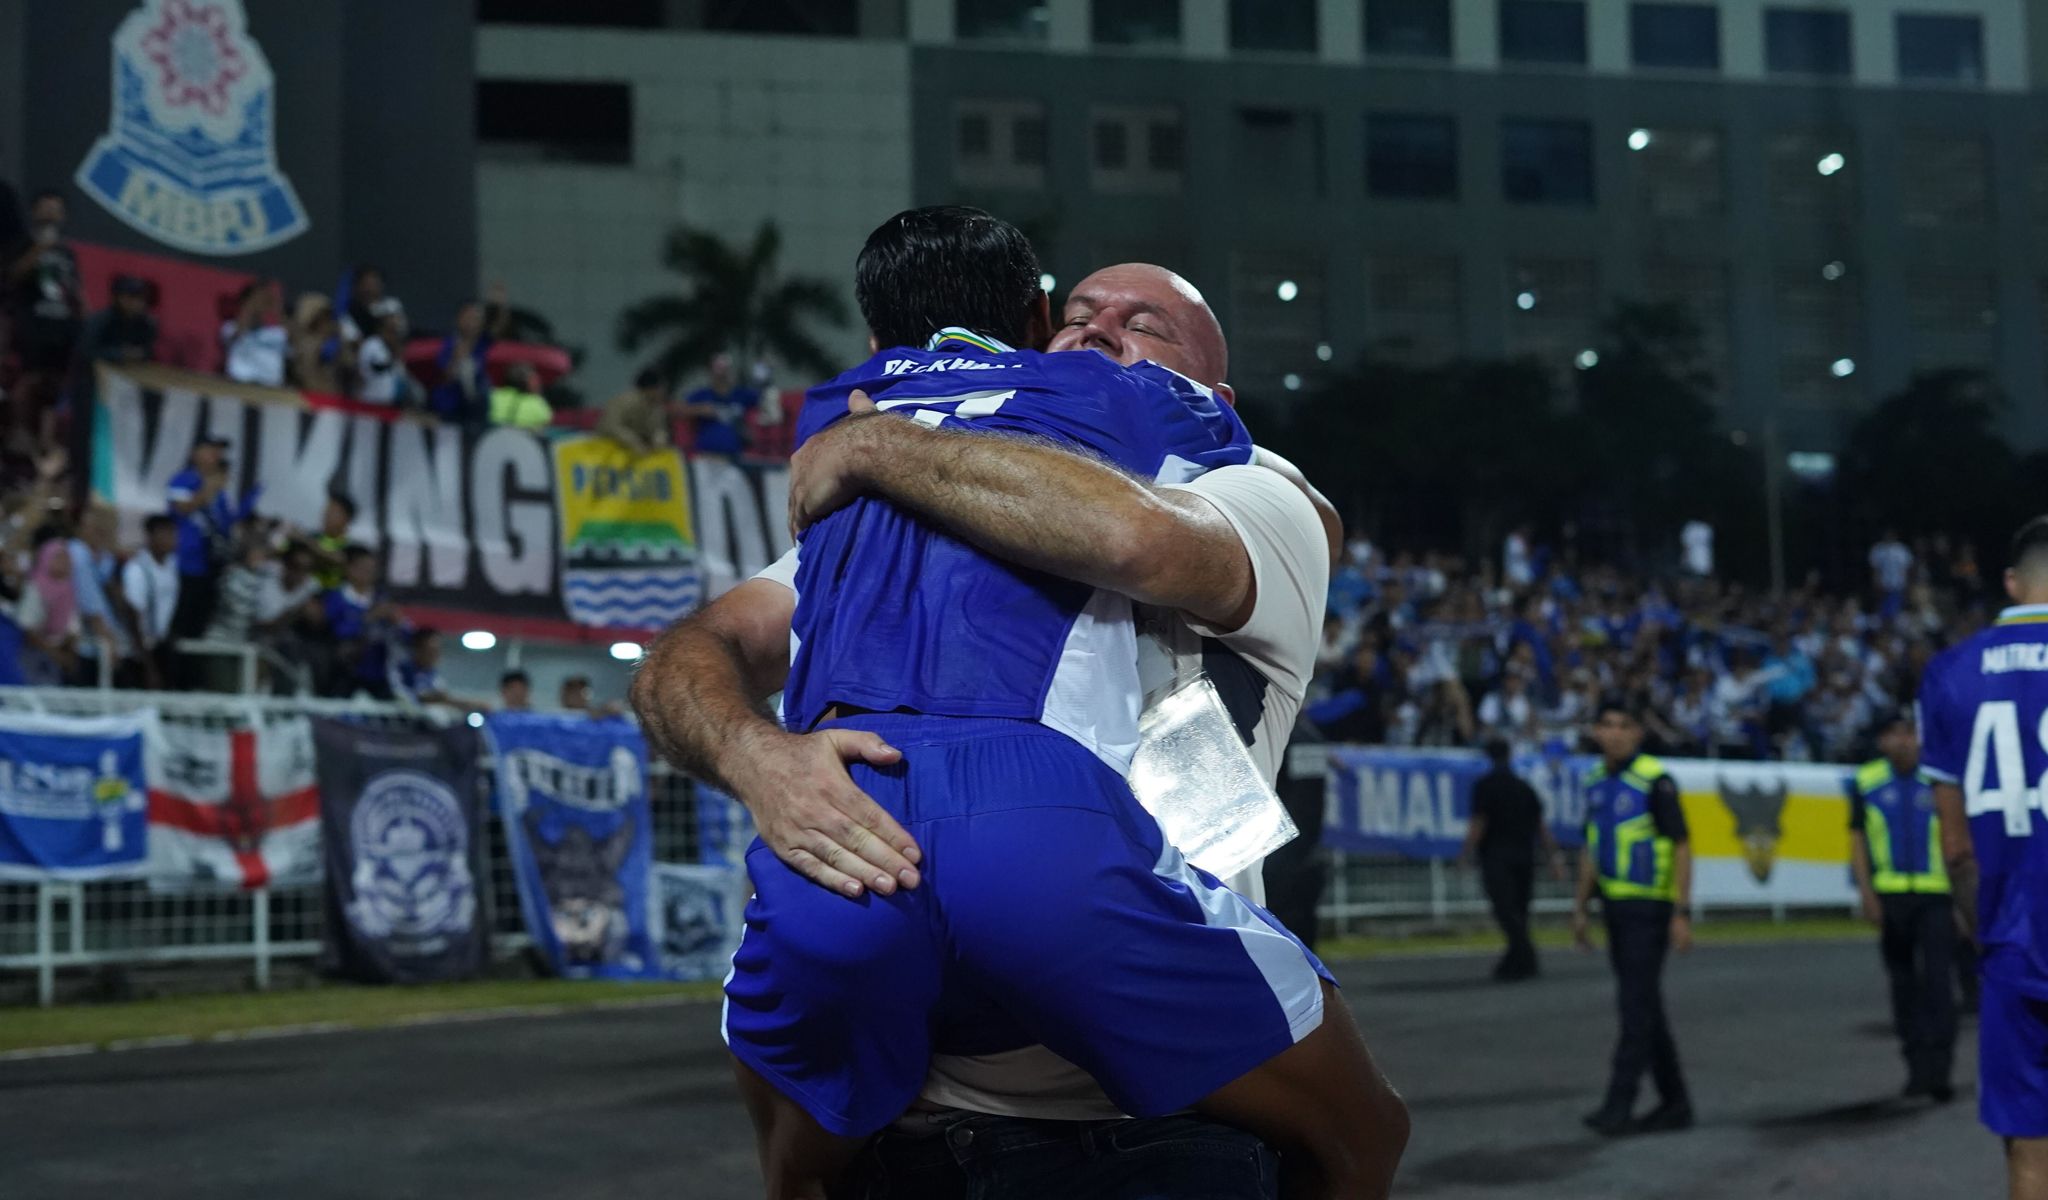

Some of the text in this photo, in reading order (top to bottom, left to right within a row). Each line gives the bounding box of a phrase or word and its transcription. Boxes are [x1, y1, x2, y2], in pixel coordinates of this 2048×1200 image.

[119, 169, 268, 244] MBPJ
[101, 369, 553, 595] VIKING
[572, 463, 673, 502] PERSIB
[1964, 701, 2048, 836] 4
